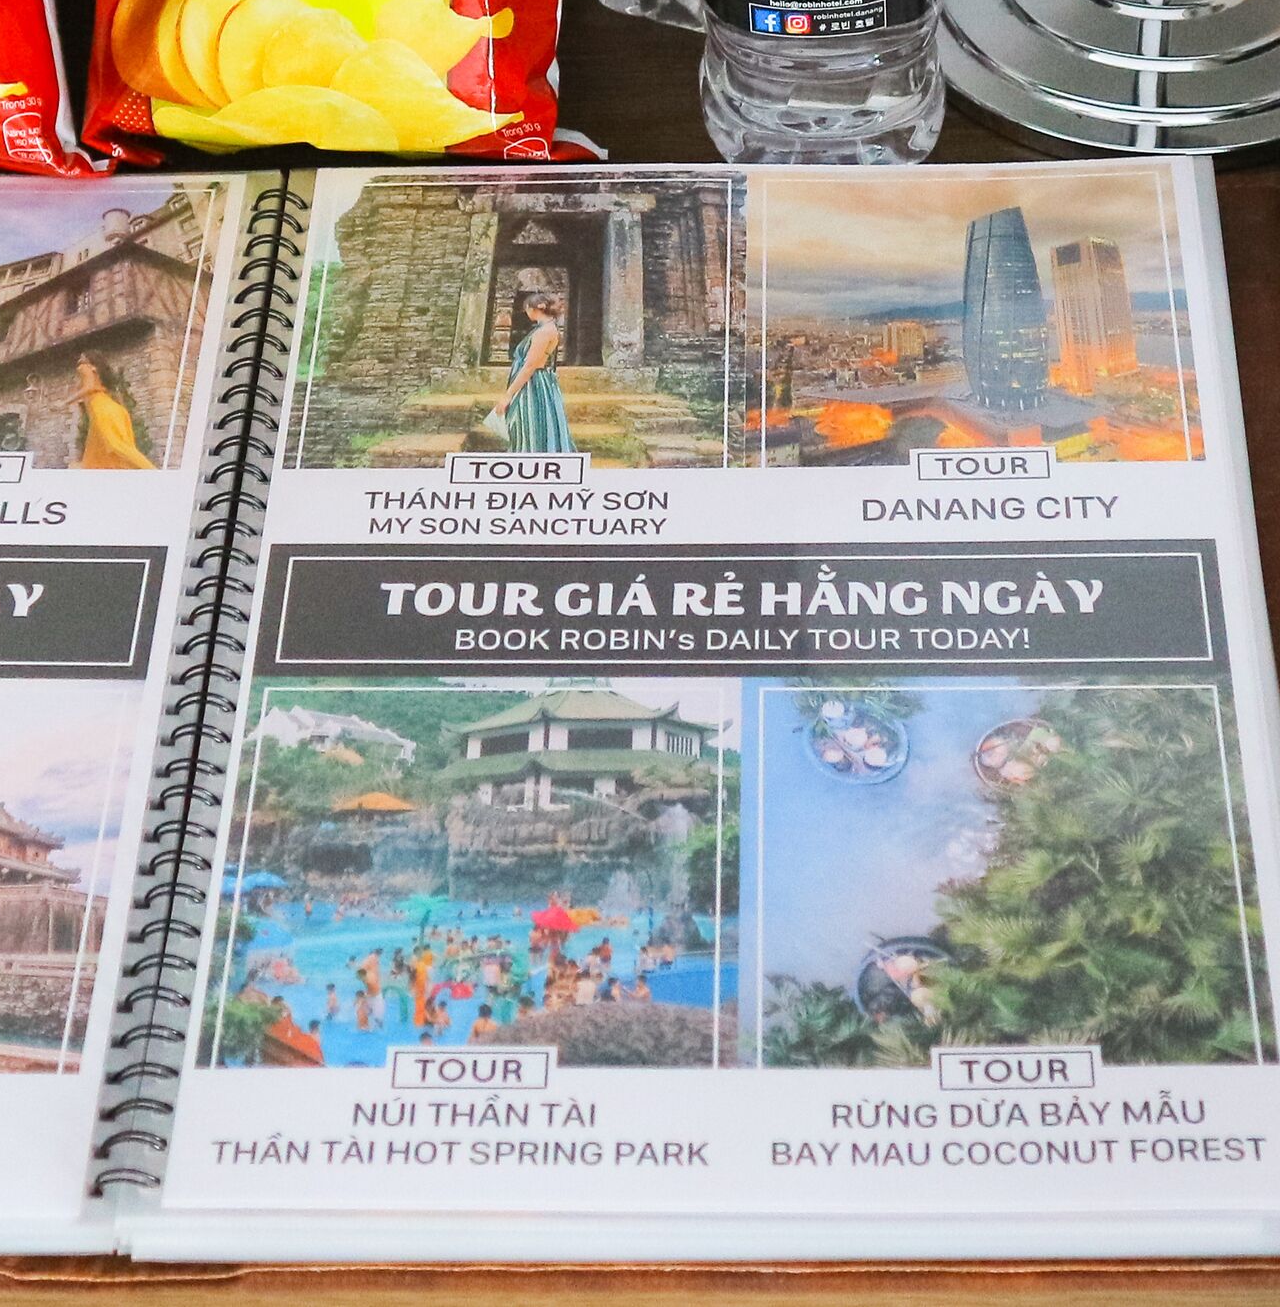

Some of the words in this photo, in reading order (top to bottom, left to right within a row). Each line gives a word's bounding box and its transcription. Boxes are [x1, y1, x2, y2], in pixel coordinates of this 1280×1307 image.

[468, 461, 564, 481] TOUR
[934, 456, 1030, 476] TOUR
[365, 487, 477, 512] THÁNH
[484, 490, 539, 515] ĐỊA
[547, 487, 600, 511] MỸ
[602, 489, 670, 511] SƠN
[861, 497, 1027, 523] DANANG
[1035, 495, 1121, 520] CITY
[368, 517, 413, 536] MY
[418, 516, 482, 536] SON
[488, 516, 669, 537] SANCTUARY
[414, 1058, 523, 1084] TOUR
[960, 1058, 1070, 1084] TOUR
[351, 1096, 416, 1129] NÚI
[427, 1093, 530, 1129] THẦN
[540, 1097, 597, 1129] TÀI
[830, 1098, 939, 1130] RỪNG
[949, 1098, 1028, 1129] DỪA
[1039, 1094, 1112, 1128] BẢY
[1121, 1089, 1207, 1127] MẪU
[211, 1132, 312, 1166] THẦN
[320, 1133, 375, 1166] TÀI
[385, 1139, 462, 1166] HOT
[468, 1139, 604, 1167] SPRING
[614, 1140, 711, 1167] PARK
[771, 1140, 844, 1167] BAY
[849, 1140, 932, 1167] MAU
[941, 1138, 1120, 1166] COCONUT
[1128, 1136, 1268, 1164] FOREST
